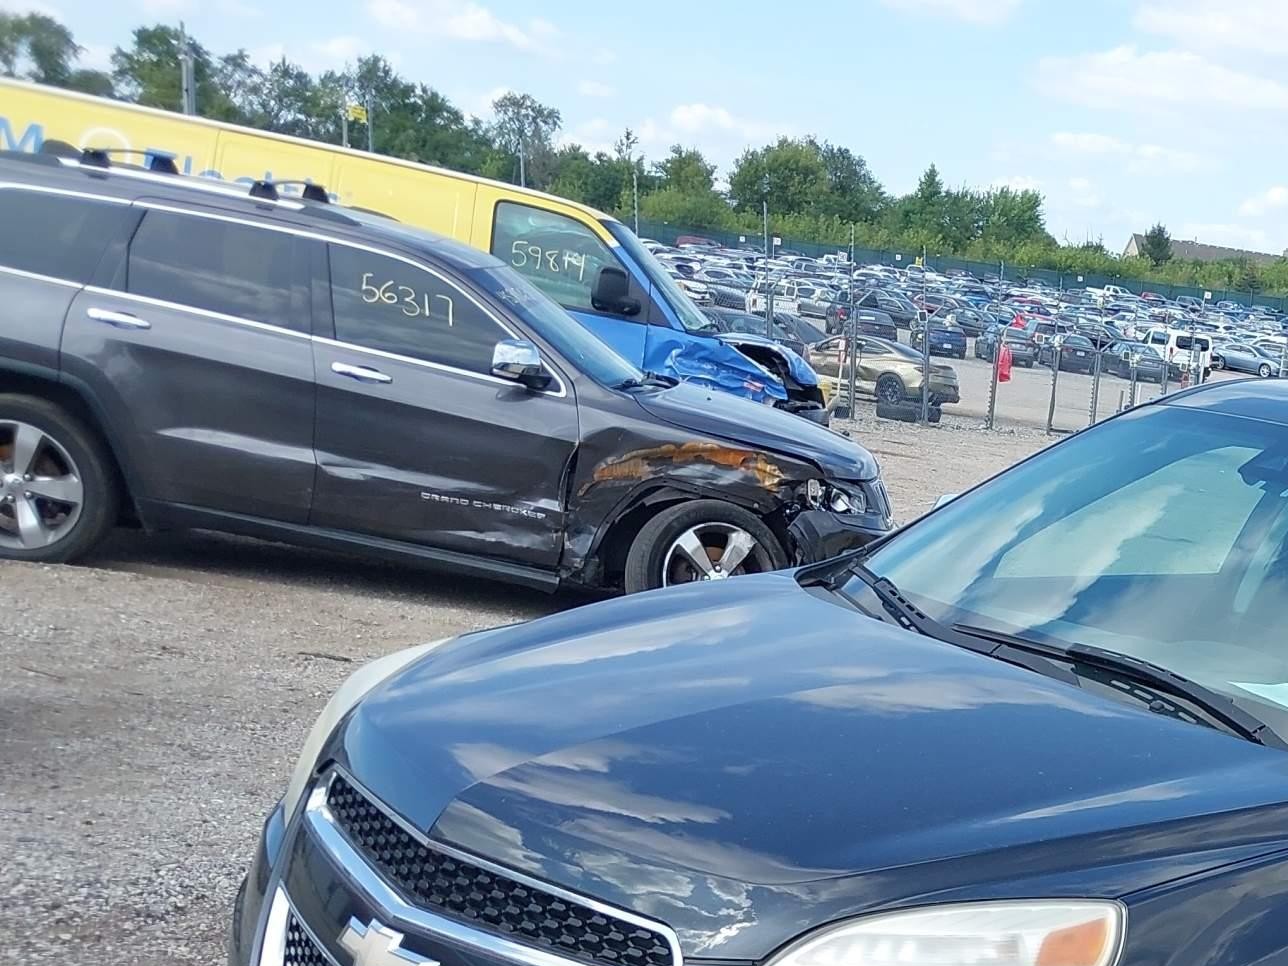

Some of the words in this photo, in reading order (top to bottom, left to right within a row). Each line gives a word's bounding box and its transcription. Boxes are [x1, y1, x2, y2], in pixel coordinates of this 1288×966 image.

[361, 273, 454, 326] 56317
[420, 491, 469, 506] GRAND
[472, 500, 546, 519] CHEROKEE
